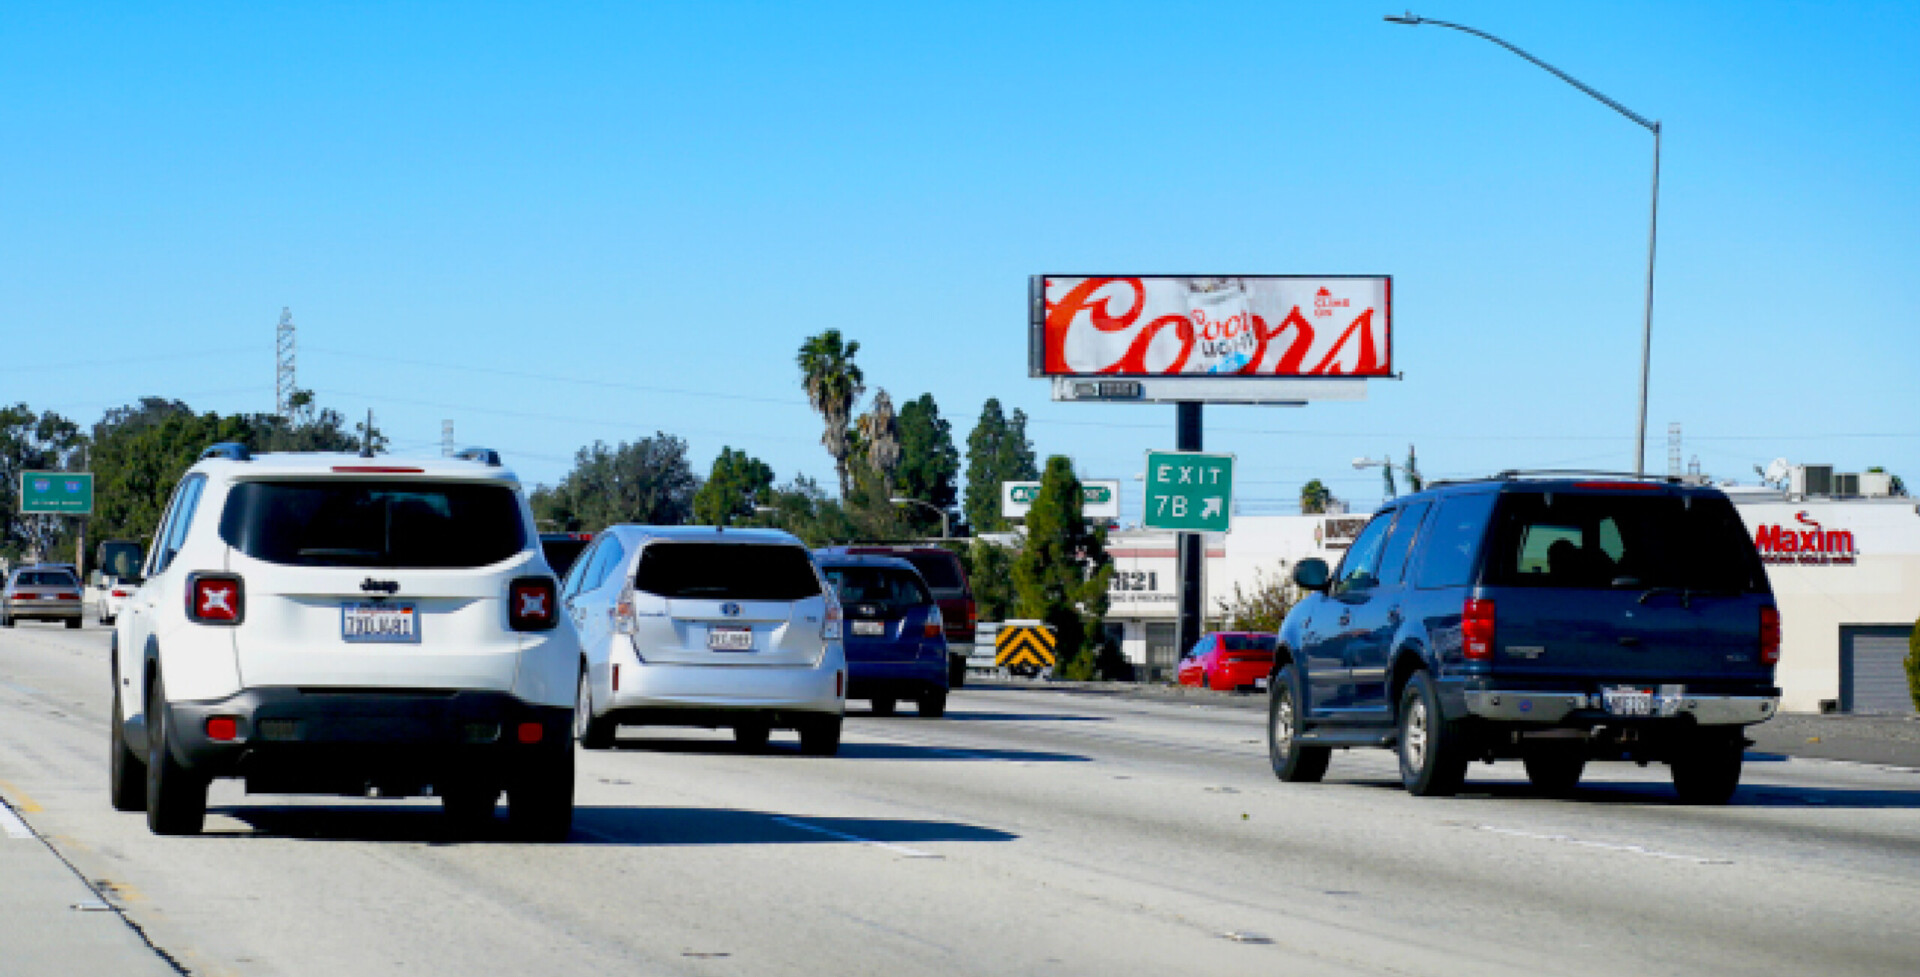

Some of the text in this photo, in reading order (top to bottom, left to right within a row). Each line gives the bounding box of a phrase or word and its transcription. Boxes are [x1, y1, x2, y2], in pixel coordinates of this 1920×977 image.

[1157, 464, 1222, 484] EXIT
[1154, 495, 1188, 518] 7B
[1754, 523, 1854, 553] Maxim
